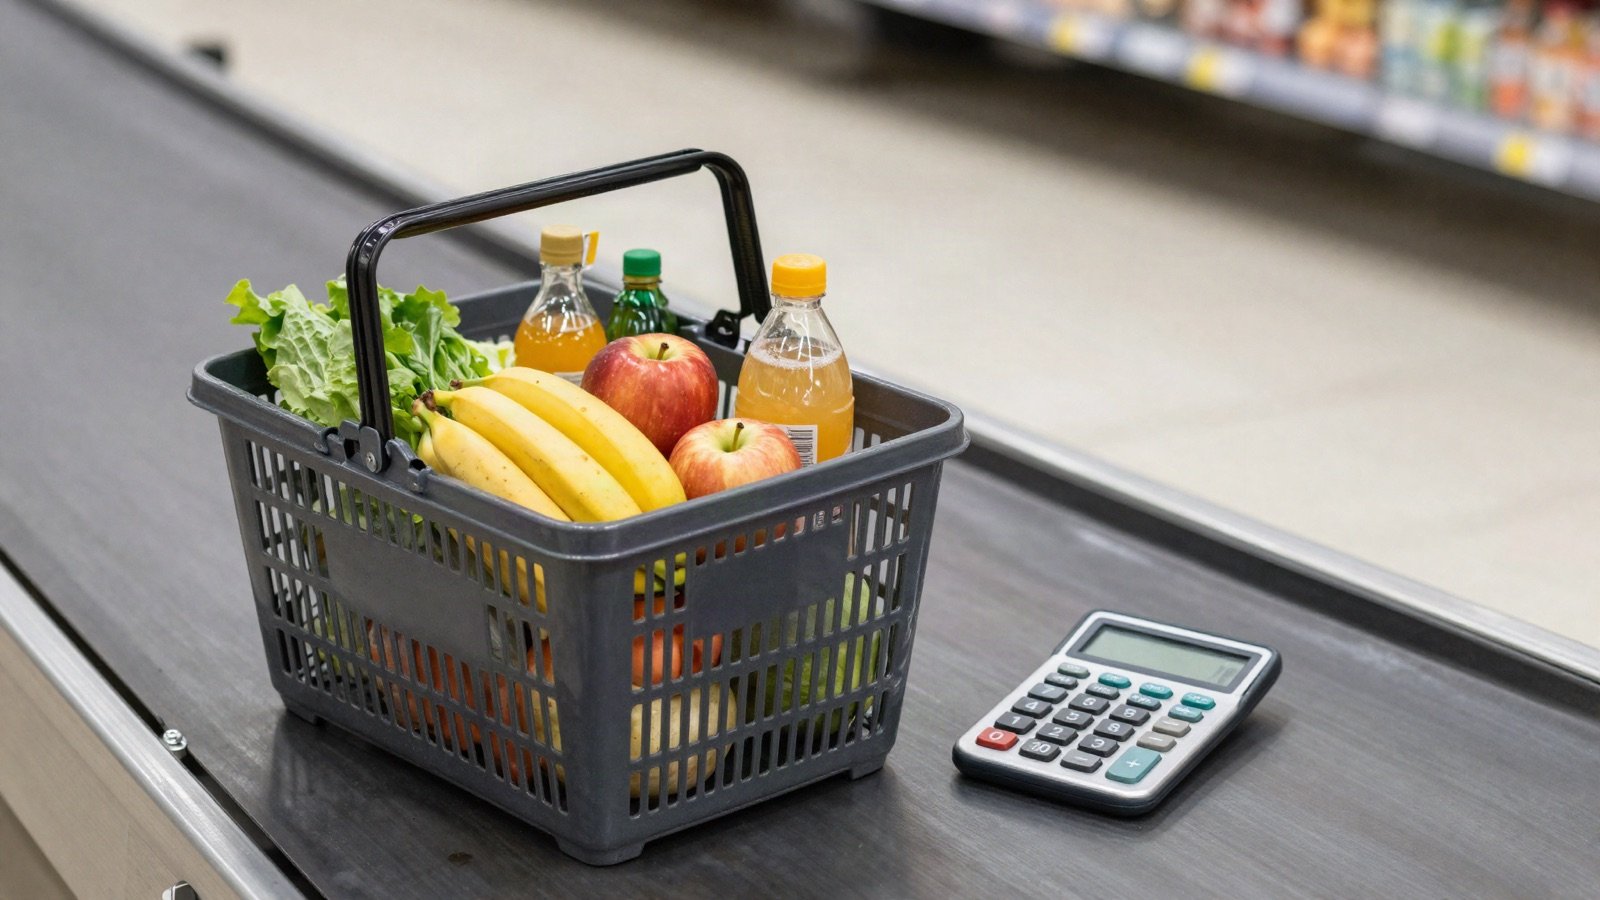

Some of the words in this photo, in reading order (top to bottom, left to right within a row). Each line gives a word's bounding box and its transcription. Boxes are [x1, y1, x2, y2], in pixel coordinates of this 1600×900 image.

[1025, 701, 1039, 710] 4
[1011, 716, 1021, 725] 1
[989, 731, 1005, 741] 0
[1048, 727, 1064, 738] 2
[1091, 738, 1105, 748] 3
